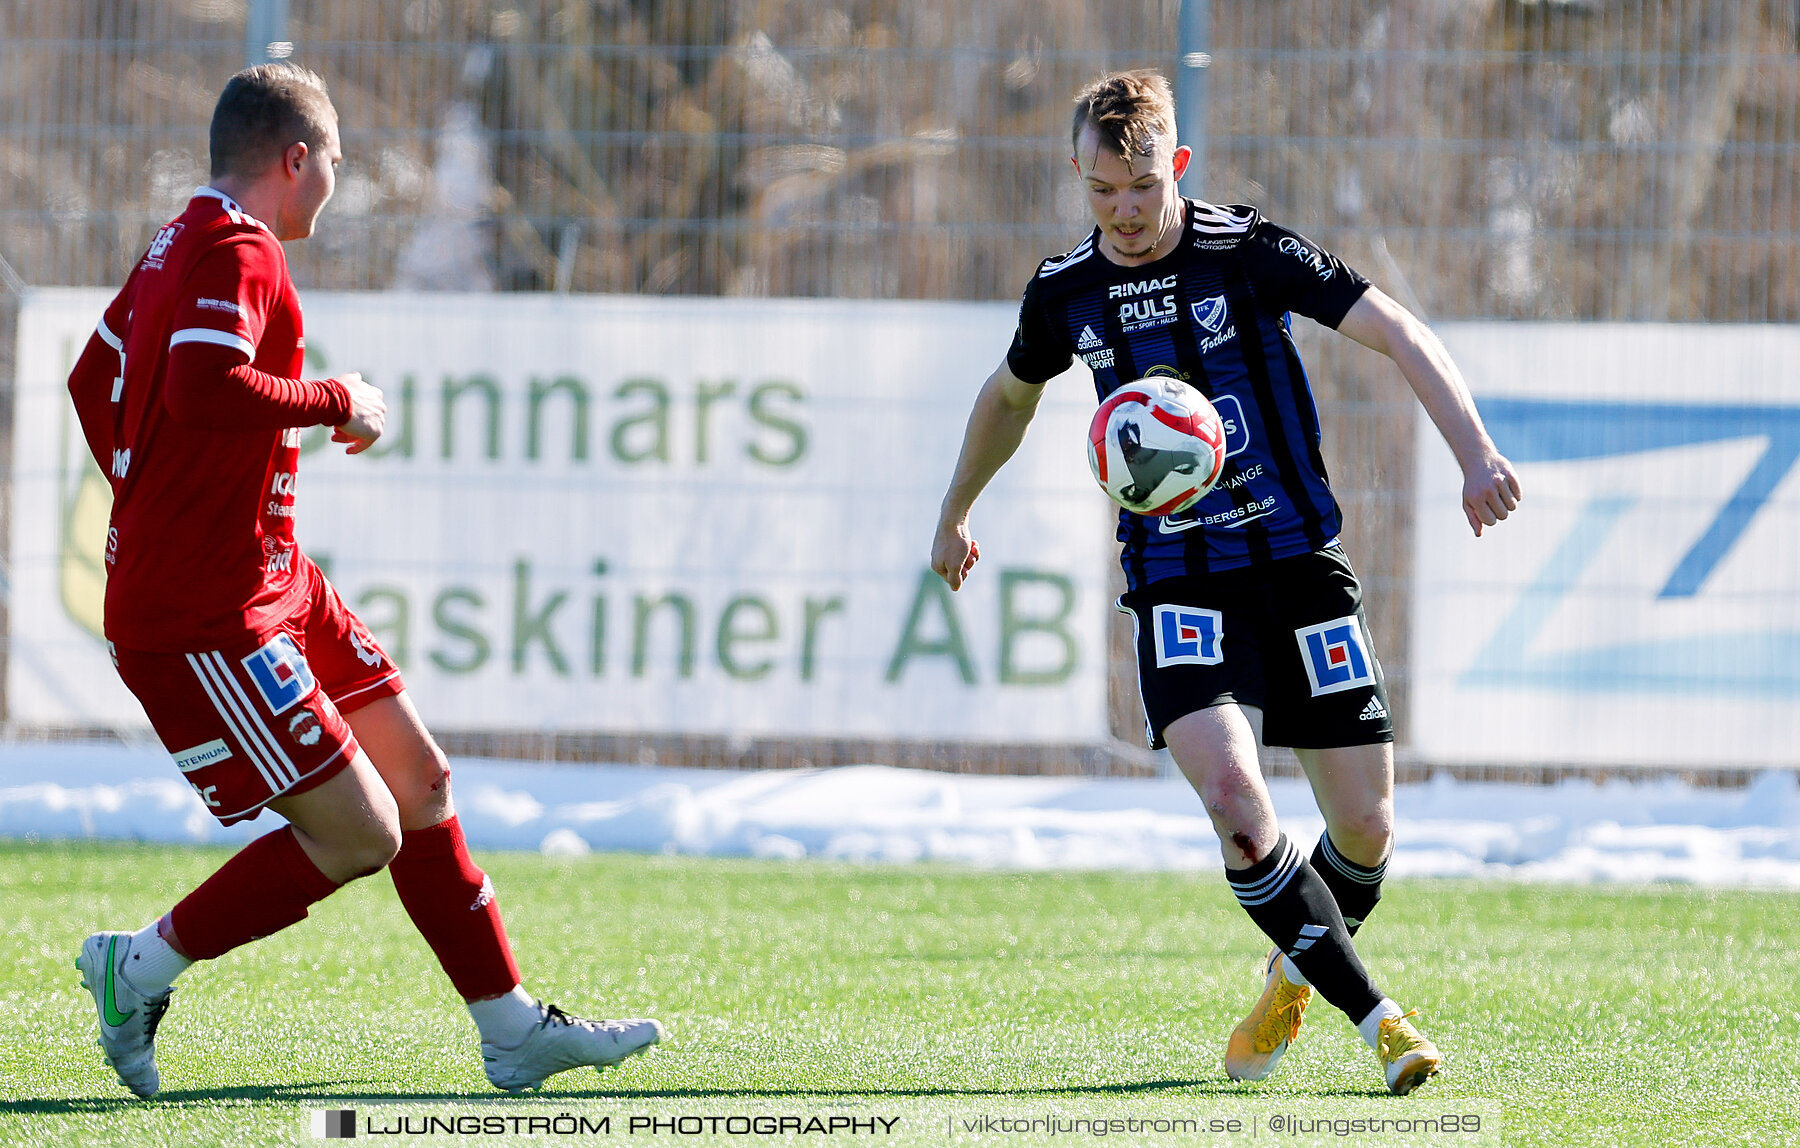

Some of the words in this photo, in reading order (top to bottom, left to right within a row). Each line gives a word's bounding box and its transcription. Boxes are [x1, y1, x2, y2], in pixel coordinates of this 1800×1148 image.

[1118, 295, 1177, 323] PULS
[1122, 325, 1135, 333] GYM
[1138, 320, 1157, 330] SPORT
[1077, 339, 1103, 350] adidas
[1200, 325, 1237, 354] Fotboll
[1090, 357, 1115, 370] SPORT
[1211, 464, 1264, 491] CHANGE
[884, 565, 1082, 688] AB
[1359, 710, 1387, 721] adidas
[176, 746, 228, 767] CTEMIUM
